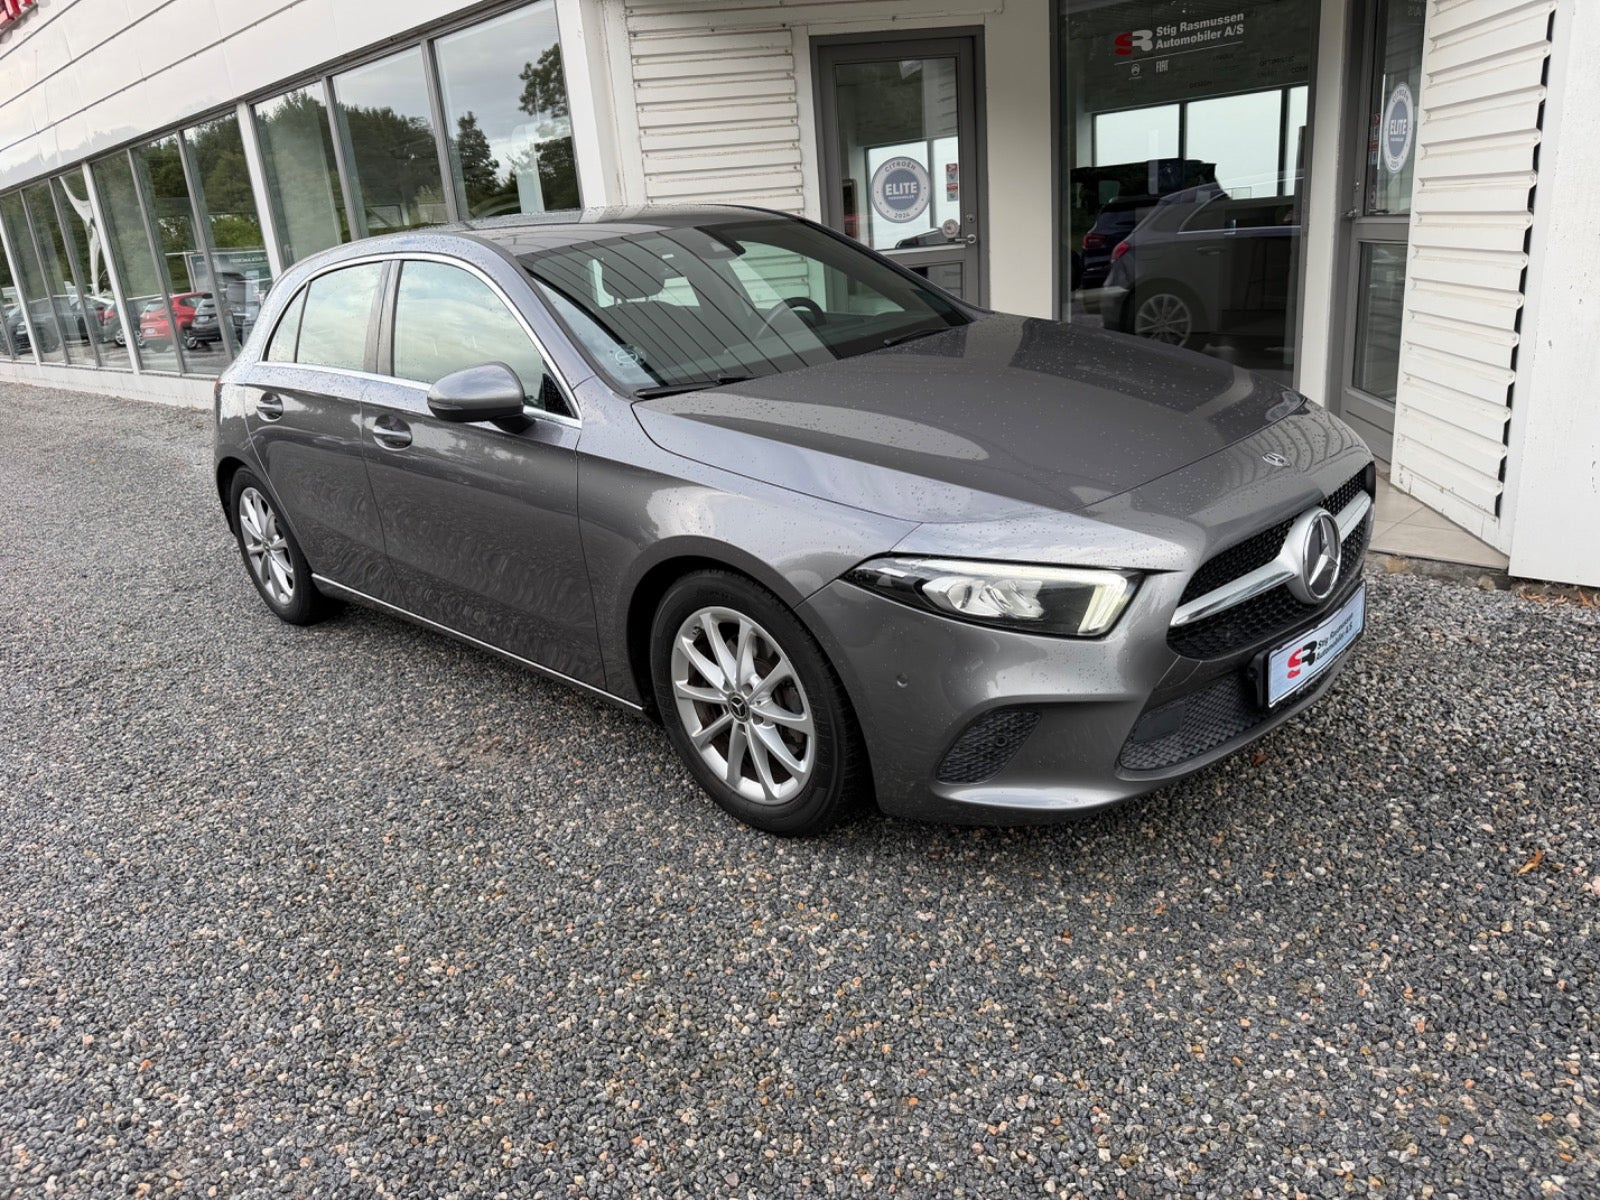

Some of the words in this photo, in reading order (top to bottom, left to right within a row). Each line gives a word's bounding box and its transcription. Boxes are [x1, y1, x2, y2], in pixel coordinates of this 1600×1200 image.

[1156, 25, 1177, 37] Stig
[1180, 12, 1245, 32] Rasmussen
[1155, 30, 1221, 49] Automobiler
[1224, 24, 1244, 37] A/S
[1156, 60, 1169, 73] FIAT
[1390, 119, 1407, 135] ELITE
[885, 161, 916, 173] CITROËN
[885, 182, 917, 196] ELITE
